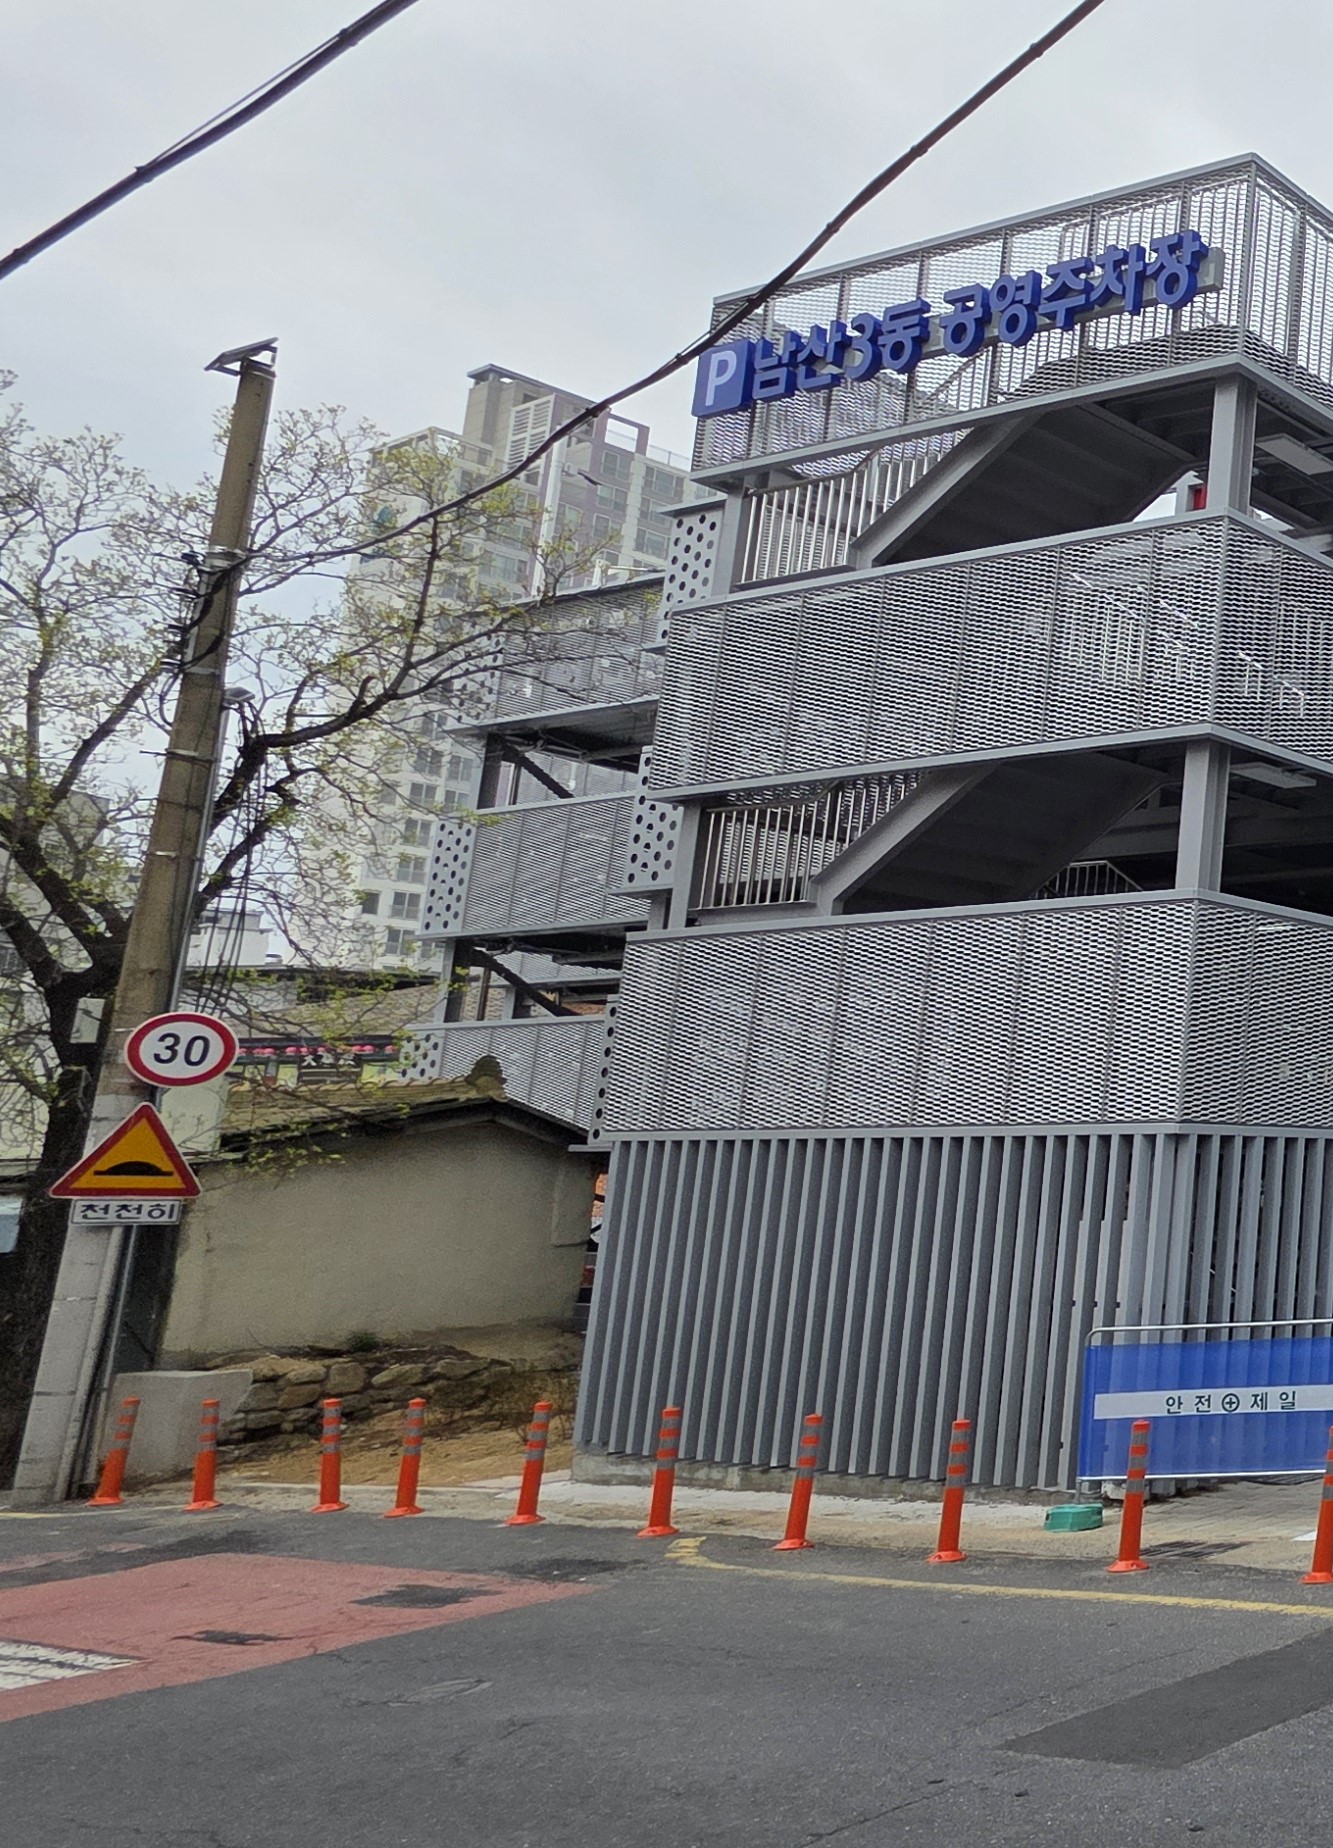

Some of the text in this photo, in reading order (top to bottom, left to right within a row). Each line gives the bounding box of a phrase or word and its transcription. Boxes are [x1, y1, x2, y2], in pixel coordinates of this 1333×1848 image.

[751, 297, 931, 402] 남산3동
[940, 229, 1209, 357] 공영주차장
[153, 1032, 211, 1067] 30
[79, 1203, 176, 1221] 천천히
